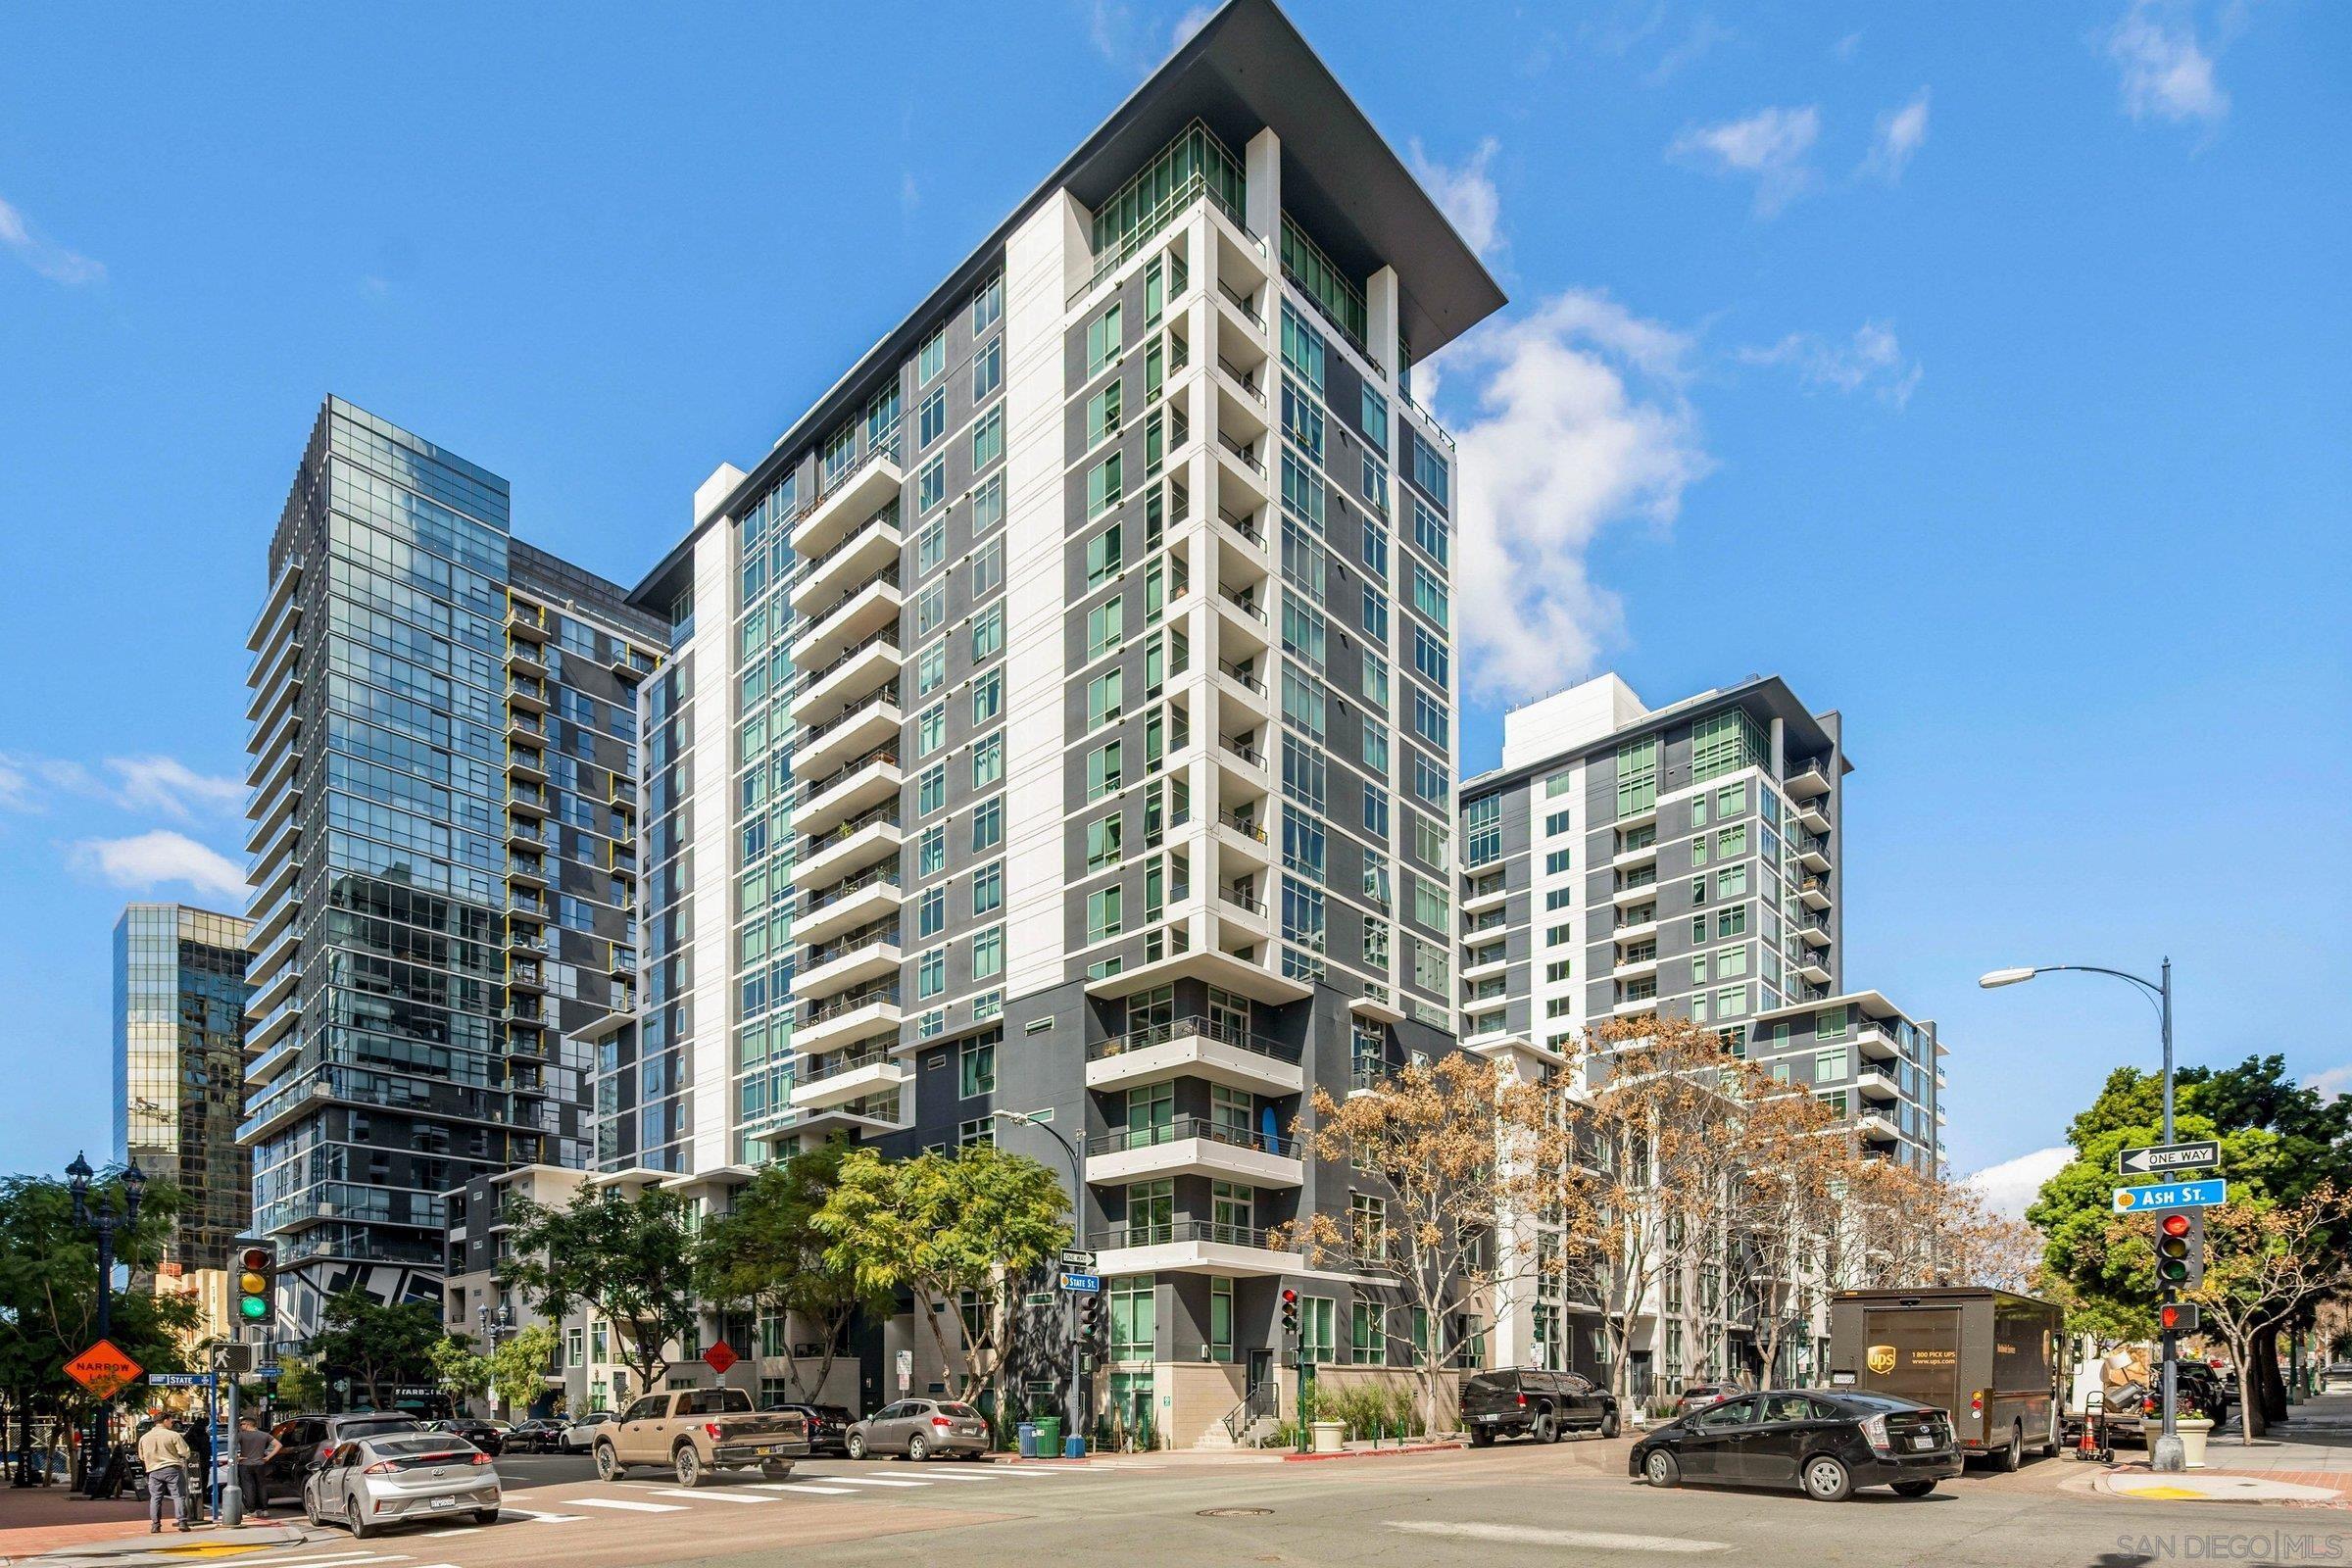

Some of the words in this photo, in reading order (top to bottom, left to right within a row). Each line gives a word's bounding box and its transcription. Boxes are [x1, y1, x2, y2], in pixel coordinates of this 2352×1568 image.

[2149, 1152, 2176, 1164] ONE
[2181, 1150, 2209, 1160] WAY
[76, 1362, 129, 1372] NARROW
[1870, 1353, 1893, 1370] ups
